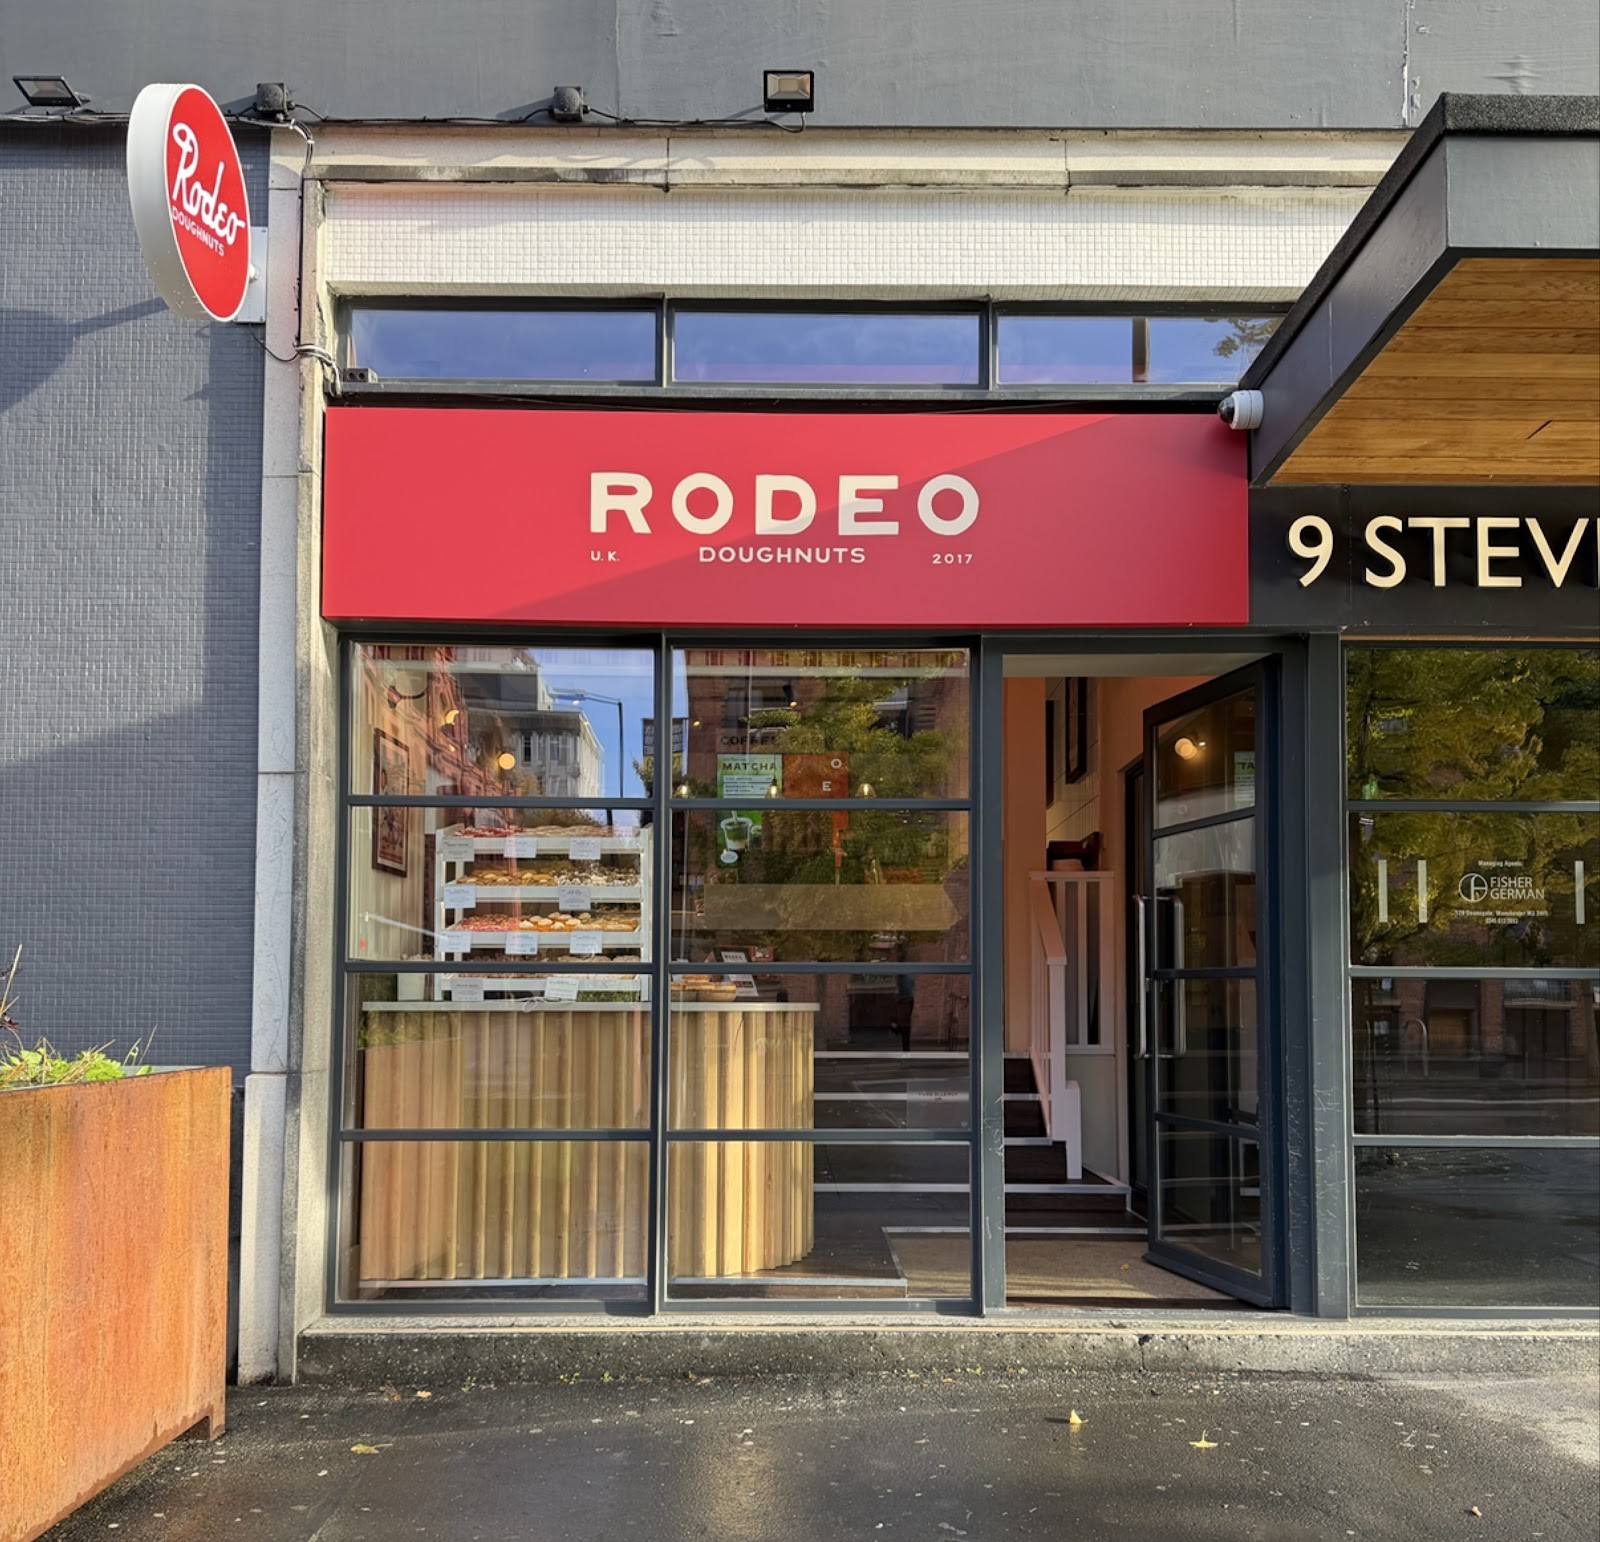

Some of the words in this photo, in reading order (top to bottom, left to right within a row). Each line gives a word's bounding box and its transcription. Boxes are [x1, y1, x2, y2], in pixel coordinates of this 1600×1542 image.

[172, 122, 246, 246] Rodeo
[171, 205, 225, 257] DOUGHNUTS
[590, 471, 980, 536] RODEO
[699, 546, 866, 564] DOUGHNUTS
[931, 553, 973, 565] 2017
[1288, 514, 1334, 588] 9
[1364, 515, 1600, 588] STEV
[722, 762, 778, 771] MATCHA
[1490, 876, 1533, 888] FISHER
[1490, 888, 1545, 900] GERMAN
